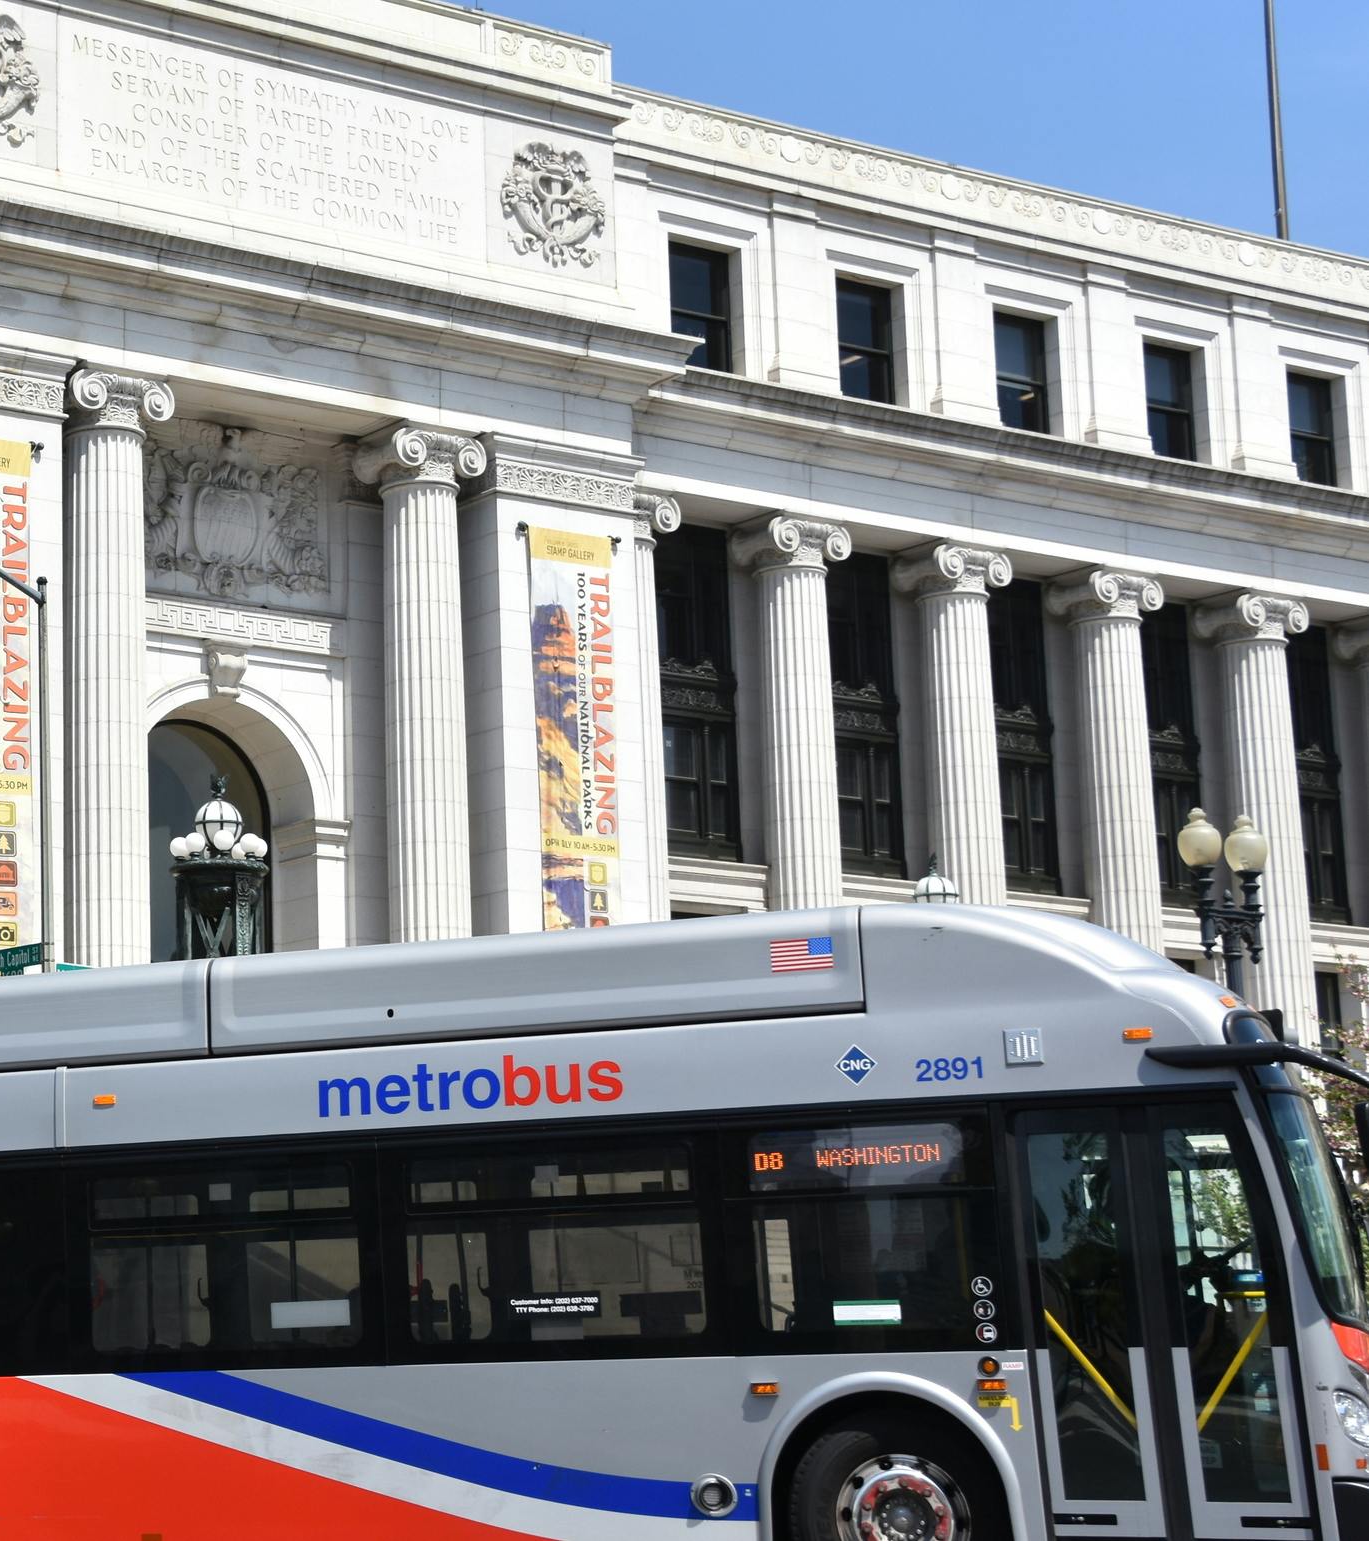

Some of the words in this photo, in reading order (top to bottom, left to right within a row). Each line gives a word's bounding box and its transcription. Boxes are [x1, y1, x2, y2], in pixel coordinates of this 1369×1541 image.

[72, 34, 207, 84] MESSENGER
[217, 69, 244, 91] OF
[254, 78, 359, 118] SYMPATHY
[372, 105, 411, 129] AND
[420, 116, 469, 144] LOVE
[111, 71, 209, 109] SERVANT
[218, 96, 244, 118] OF
[255, 104, 333, 138] PARTED
[346, 125, 439, 162] FRIENDS
[133, 103, 248, 147] CONSOLER
[259, 132, 286, 154] OF
[295, 140, 333, 165] THE
[346, 152, 421, 184] LONELY
[82, 118, 146, 149] BOND
[160, 137, 188, 159] OF
[199, 145, 240, 171] THE
[255, 158, 380, 200] SCATTERED
[394, 188, 463, 218] FAMILY
[91, 148, 209, 192] ENLARGER
[222, 177, 248, 199] OF
[260, 185, 300, 210] THE
[312, 197, 405, 232] COMMON
[418, 219, 457, 244] LIFE
[546, 545, 567, 556] STAMP
[567, 548, 595, 561] GALLERY
[577, 572, 586, 599] 100
[577, 603, 587, 651] YEARS
[578, 654, 586, 670] OF
[578, 672, 586, 697] OUR
[589, 573, 616, 835] TRAILBLAZING
[579, 700, 591, 774] NATIONAL
[17, 781, 28, 790] PM
[582, 779, 593, 830] PARKS
[6, 949, 30, 967] Capitol
[317, 1054, 624, 1118] metrobus
[839, 1058, 872, 1072] CNG
[915, 1056, 983, 1082] 2891
[754, 1152, 783, 1171] D8
[815, 1143, 940, 1168] WASHINGTON
